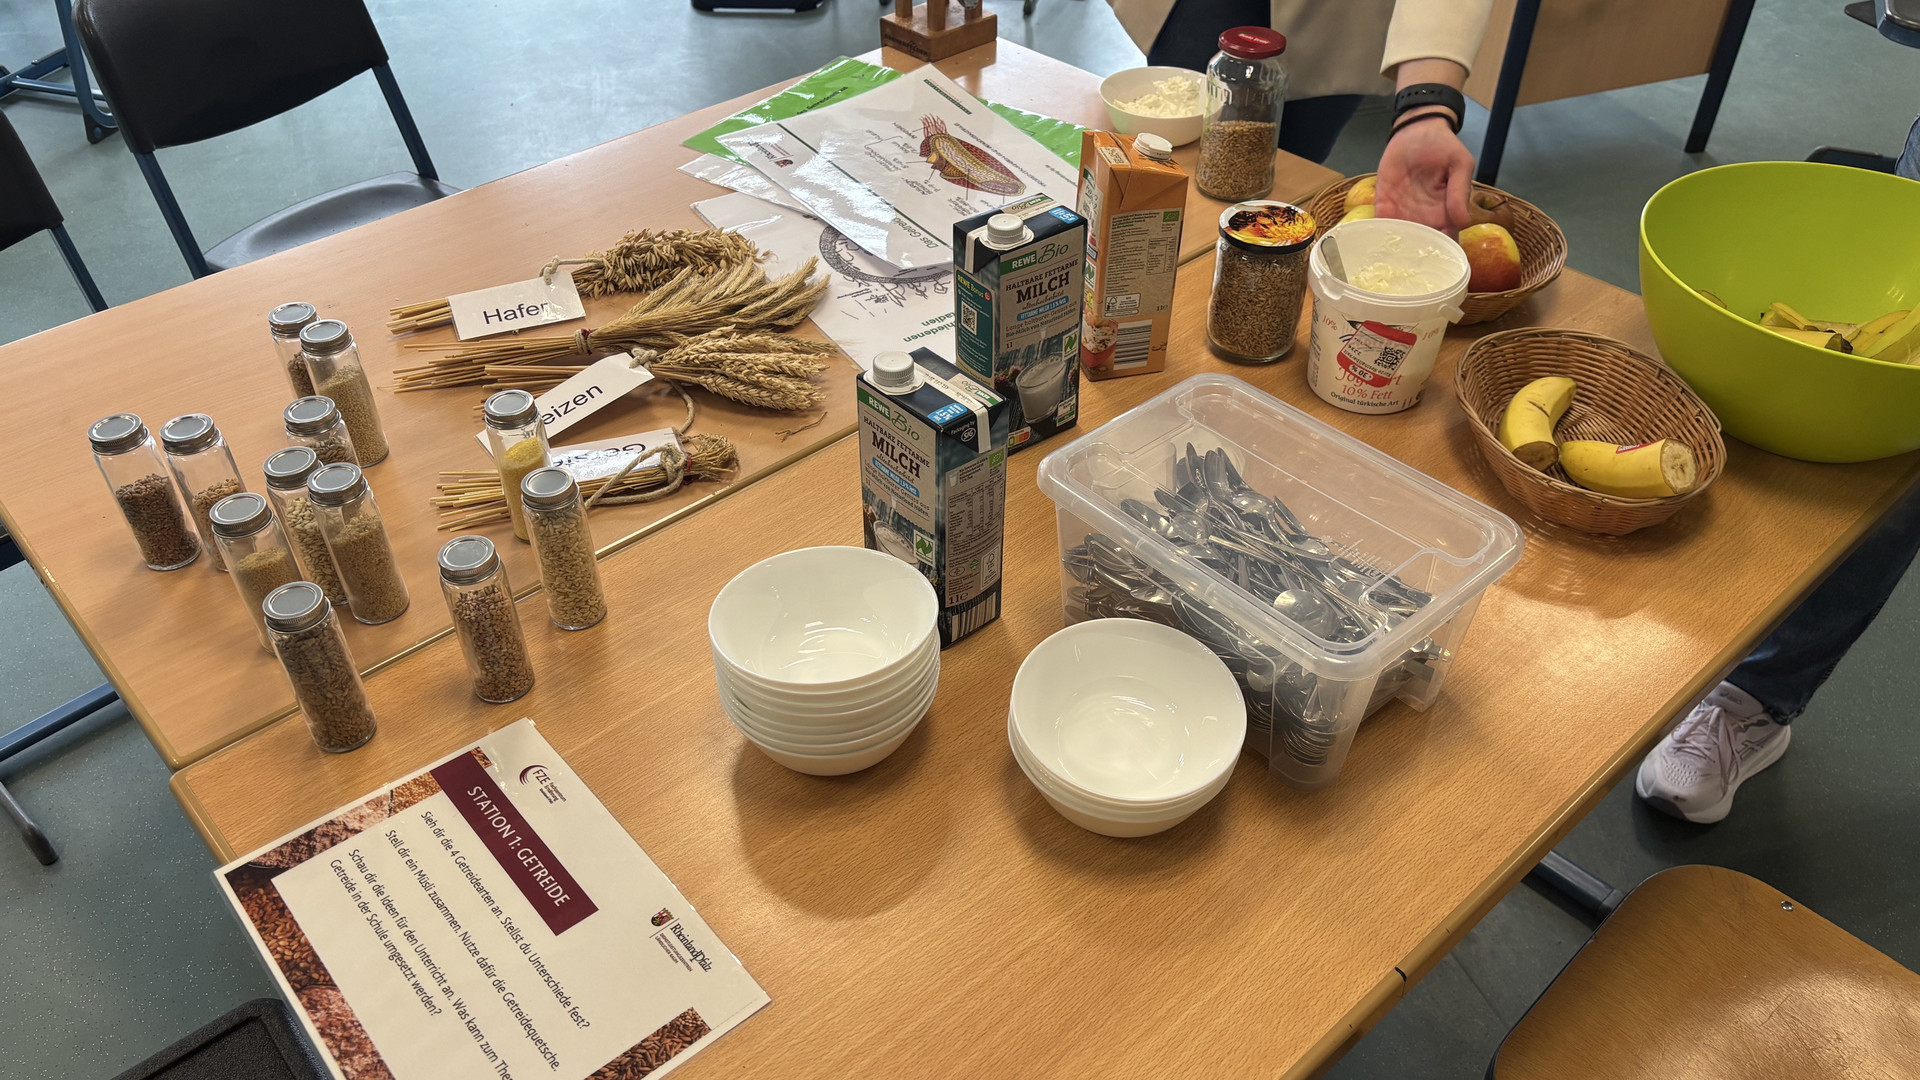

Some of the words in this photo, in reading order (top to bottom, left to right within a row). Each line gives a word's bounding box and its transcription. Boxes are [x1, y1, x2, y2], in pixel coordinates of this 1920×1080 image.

[919, 237, 940, 249] Das
[1011, 254, 1036, 270] REWE
[1038, 242, 1069, 265] Bio
[1005, 273, 1044, 292] HALTBARE
[1044, 259, 1079, 278] FETTARME
[1016, 271, 1070, 304] MILCH
[483, 301, 550, 325] Hafer
[541, 384, 604, 425] eizen
[1330, 391, 1356, 405] Original
[1342, 384, 1368, 399] 10%
[1370, 390, 1393, 400] Fett
[868, 396, 890, 418] REWE
[890, 409, 920, 441] Bio
[950, 423, 968, 435] Packaging
[967, 420, 976, 428] by
[863, 415, 896, 443] HALTBARE
[895, 438, 930, 468] FETTARME
[962, 430, 975, 440] SIG
[871, 430, 921, 479] MILCH
[532, 768, 551, 785] FZE
[420, 810, 438, 829] Sieh
[432, 827, 446, 839] dir
[440, 838, 454, 852] die
[466, 785, 516, 839] STATION
[508, 835, 523, 850] 1:
[516, 847, 571, 907] GETREIDE
[450, 850, 461, 858] 4
[454, 855, 496, 907] Getreidearten
[490, 905, 504, 920] an.
[330, 859, 357, 894] Getreide
[350, 890, 363, 903] in
[357, 901, 372, 915] der
[365, 913, 389, 942] Schule
[383, 939, 417, 982] umgesetzt
[411, 979, 443, 1017] werden?
[499, 916, 525, 944] Stellst
[348, 848, 369, 874] Schau
[364, 872, 378, 887] dir
[371, 884, 385, 898] die
[379, 894, 400, 919] Ideen
[394, 916, 409, 930] für
[403, 929, 419, 947] den
[414, 943, 448, 987] Unterricht
[441, 985, 455, 1001] an.
[451, 997, 470, 1021] Was
[464, 1016, 485, 1043] kann
[479, 1040, 499, 1063] zum
[384, 829, 405, 850] Stell
[397, 847, 411, 859] dir
[405, 858, 419, 872] ein
[413, 869, 436, 893] Müsli
[427, 890, 462, 934] zusammen.
[458, 930, 481, 958] Nutze
[475, 956, 497, 979] dafür
[491, 978, 506, 994] die
[502, 991, 560, 1072] Getreidequetsche.
[519, 942, 532, 956] du
[528, 952, 572, 1009] Unterschiede
[567, 1005, 591, 1030] fest?
